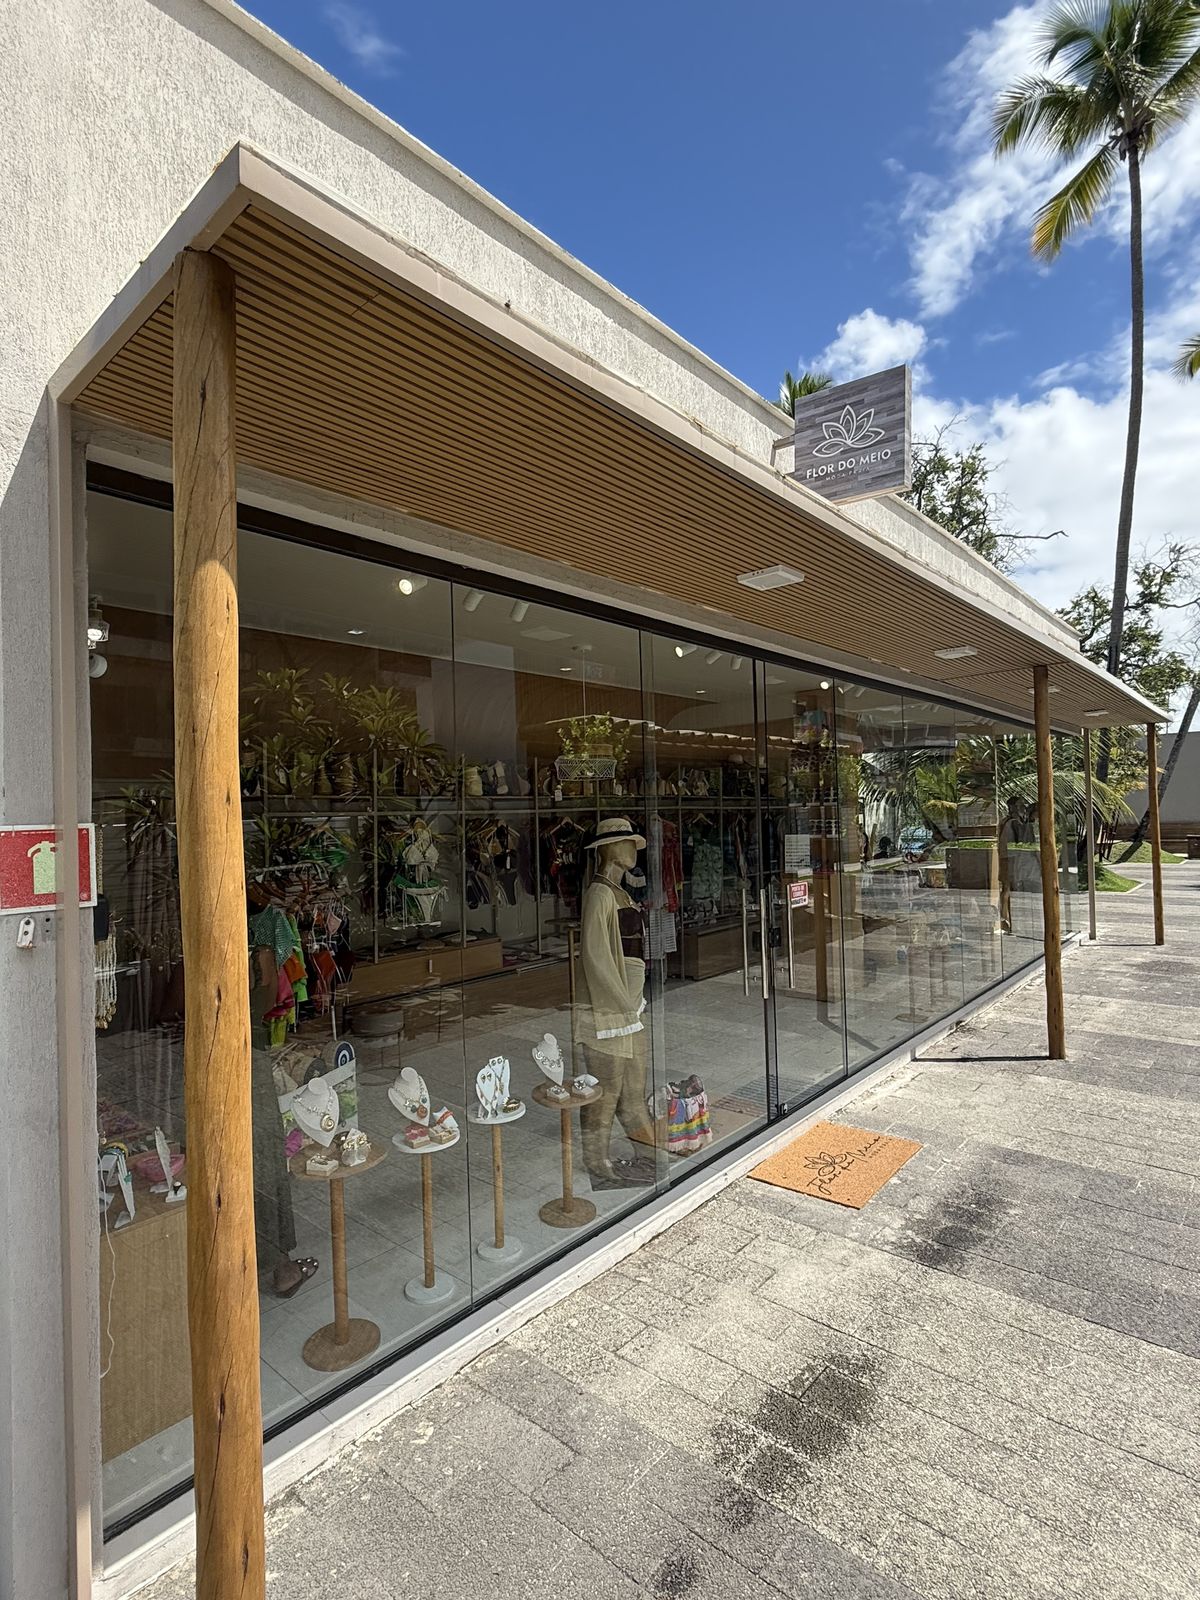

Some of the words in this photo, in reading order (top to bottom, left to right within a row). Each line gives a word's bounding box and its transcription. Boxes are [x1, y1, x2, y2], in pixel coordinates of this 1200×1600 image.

[806, 463, 835, 479] FLOR
[838, 458, 856, 471] DO
[859, 449, 891, 466] MEIO
